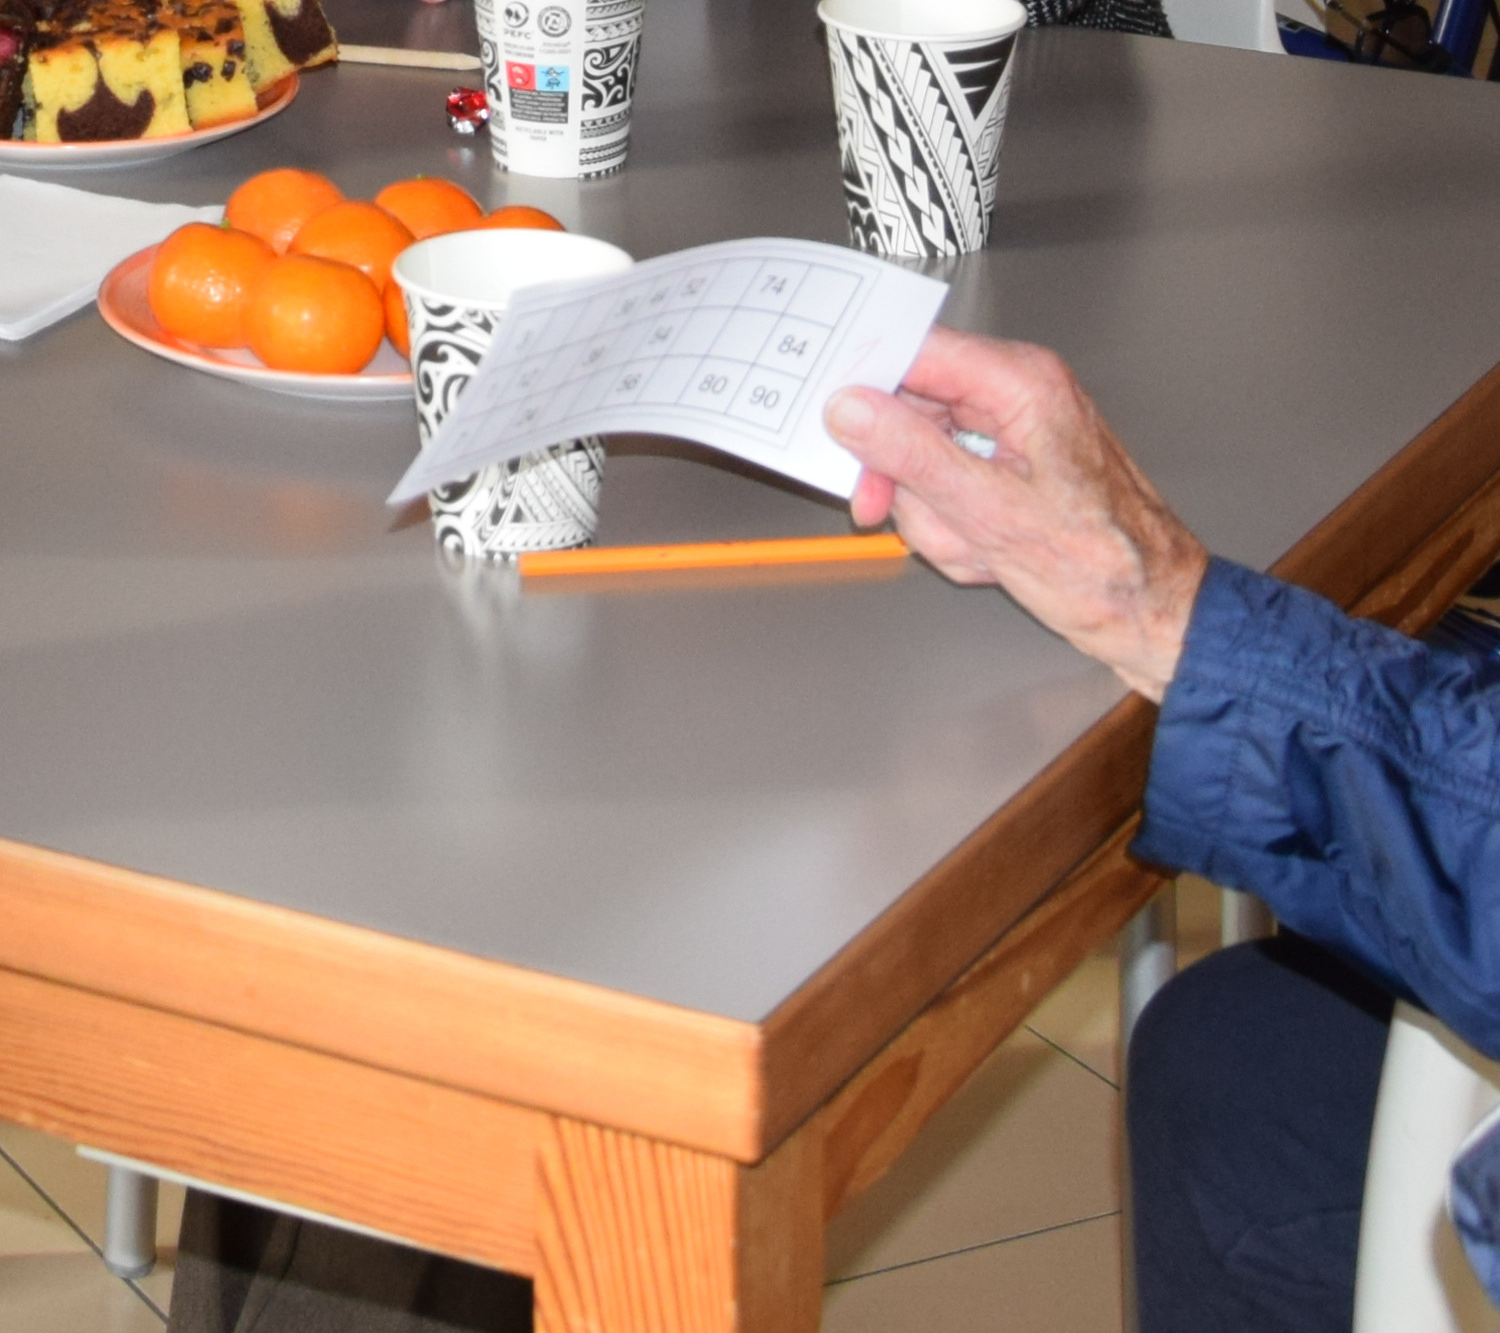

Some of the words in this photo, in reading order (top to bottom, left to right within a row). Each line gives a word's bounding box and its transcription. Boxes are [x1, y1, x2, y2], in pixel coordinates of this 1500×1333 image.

[760, 274, 787, 295] 74
[777, 334, 808, 357] 84
[697, 373, 729, 395] 80
[749, 386, 780, 409] 90
